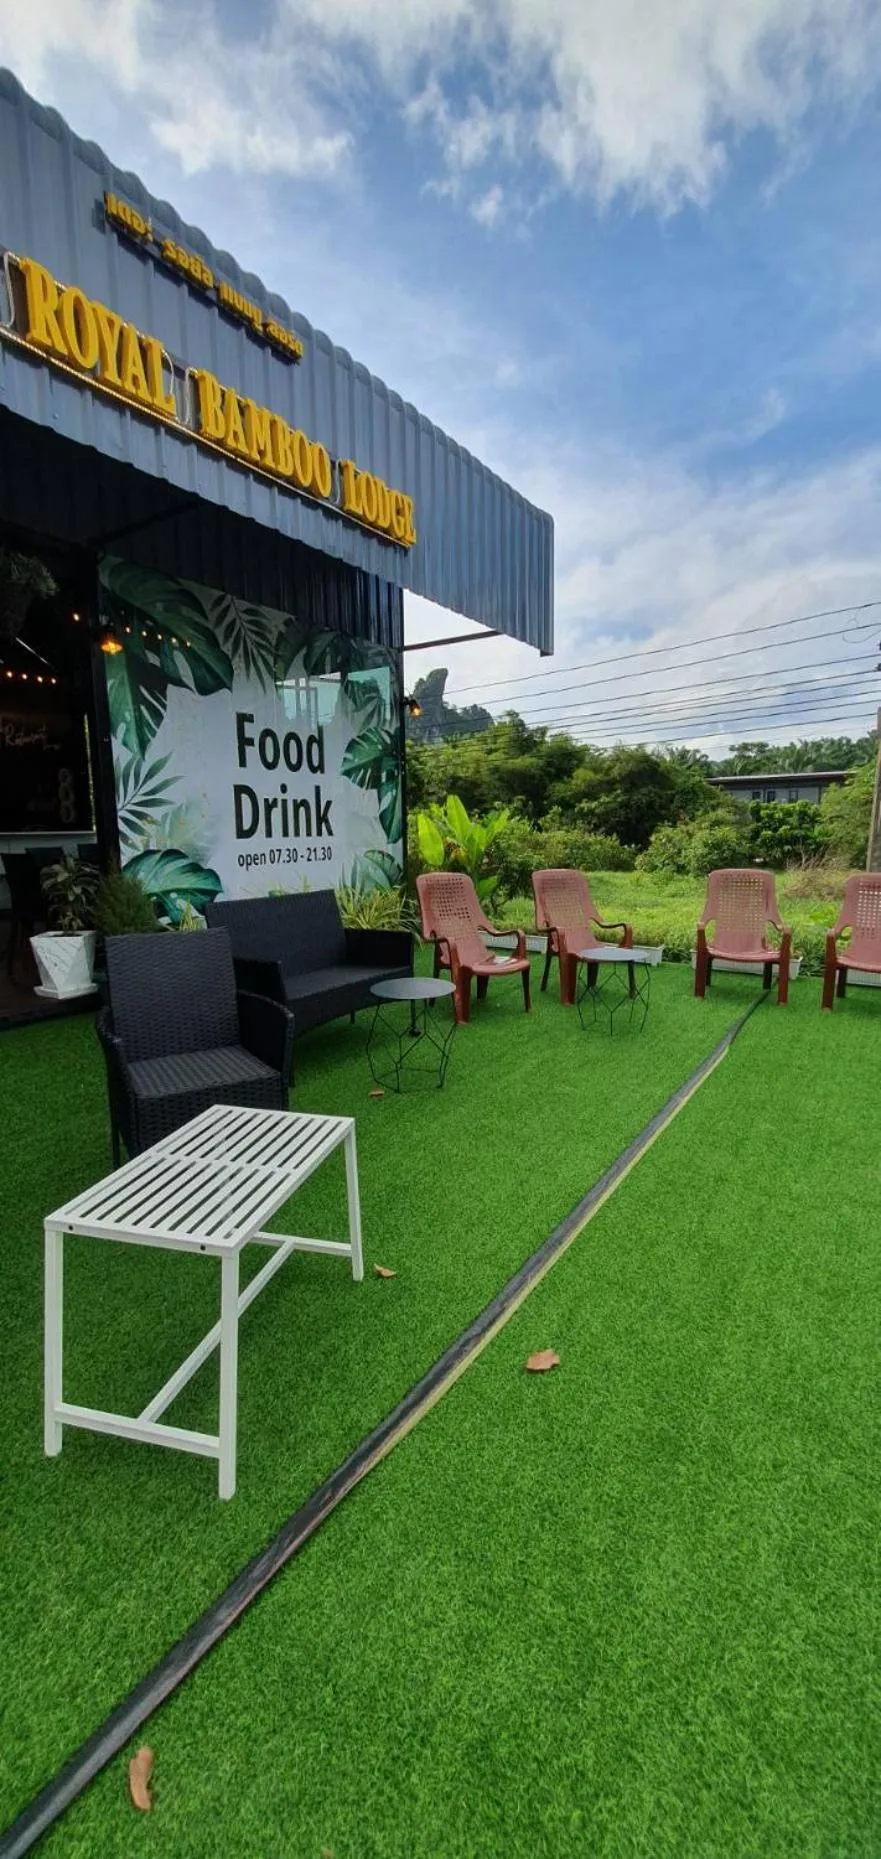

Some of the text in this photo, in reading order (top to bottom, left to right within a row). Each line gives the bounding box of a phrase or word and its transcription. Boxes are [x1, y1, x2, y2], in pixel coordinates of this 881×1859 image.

[19, 257, 416, 546] ROYAL BAMBOO LODGE
[236, 711, 325, 774] Food
[233, 783, 334, 839] Drink
[237, 853, 267, 871] open
[269, 848, 298, 865] 07.30
[306, 846, 333, 863] 21.30
